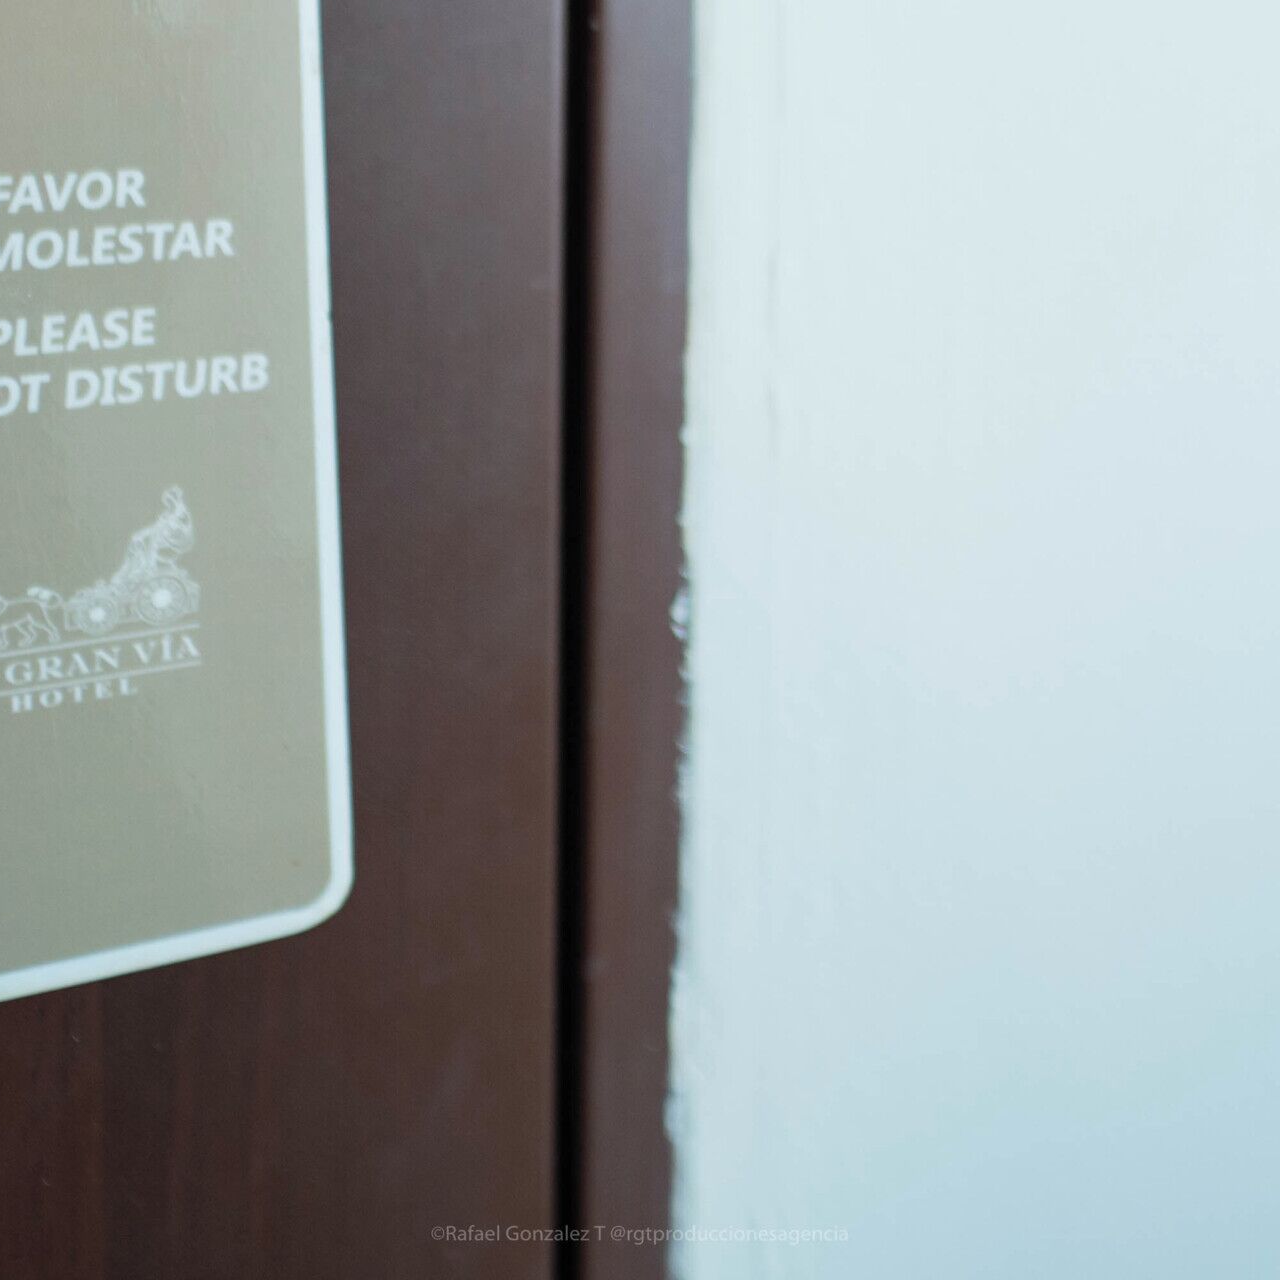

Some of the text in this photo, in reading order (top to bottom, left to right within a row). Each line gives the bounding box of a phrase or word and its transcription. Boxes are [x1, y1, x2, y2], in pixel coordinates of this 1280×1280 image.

[64, 353, 270, 410] DISTURB
[5, 648, 120, 685] GRAN
[11, 678, 138, 713] HOTEL
